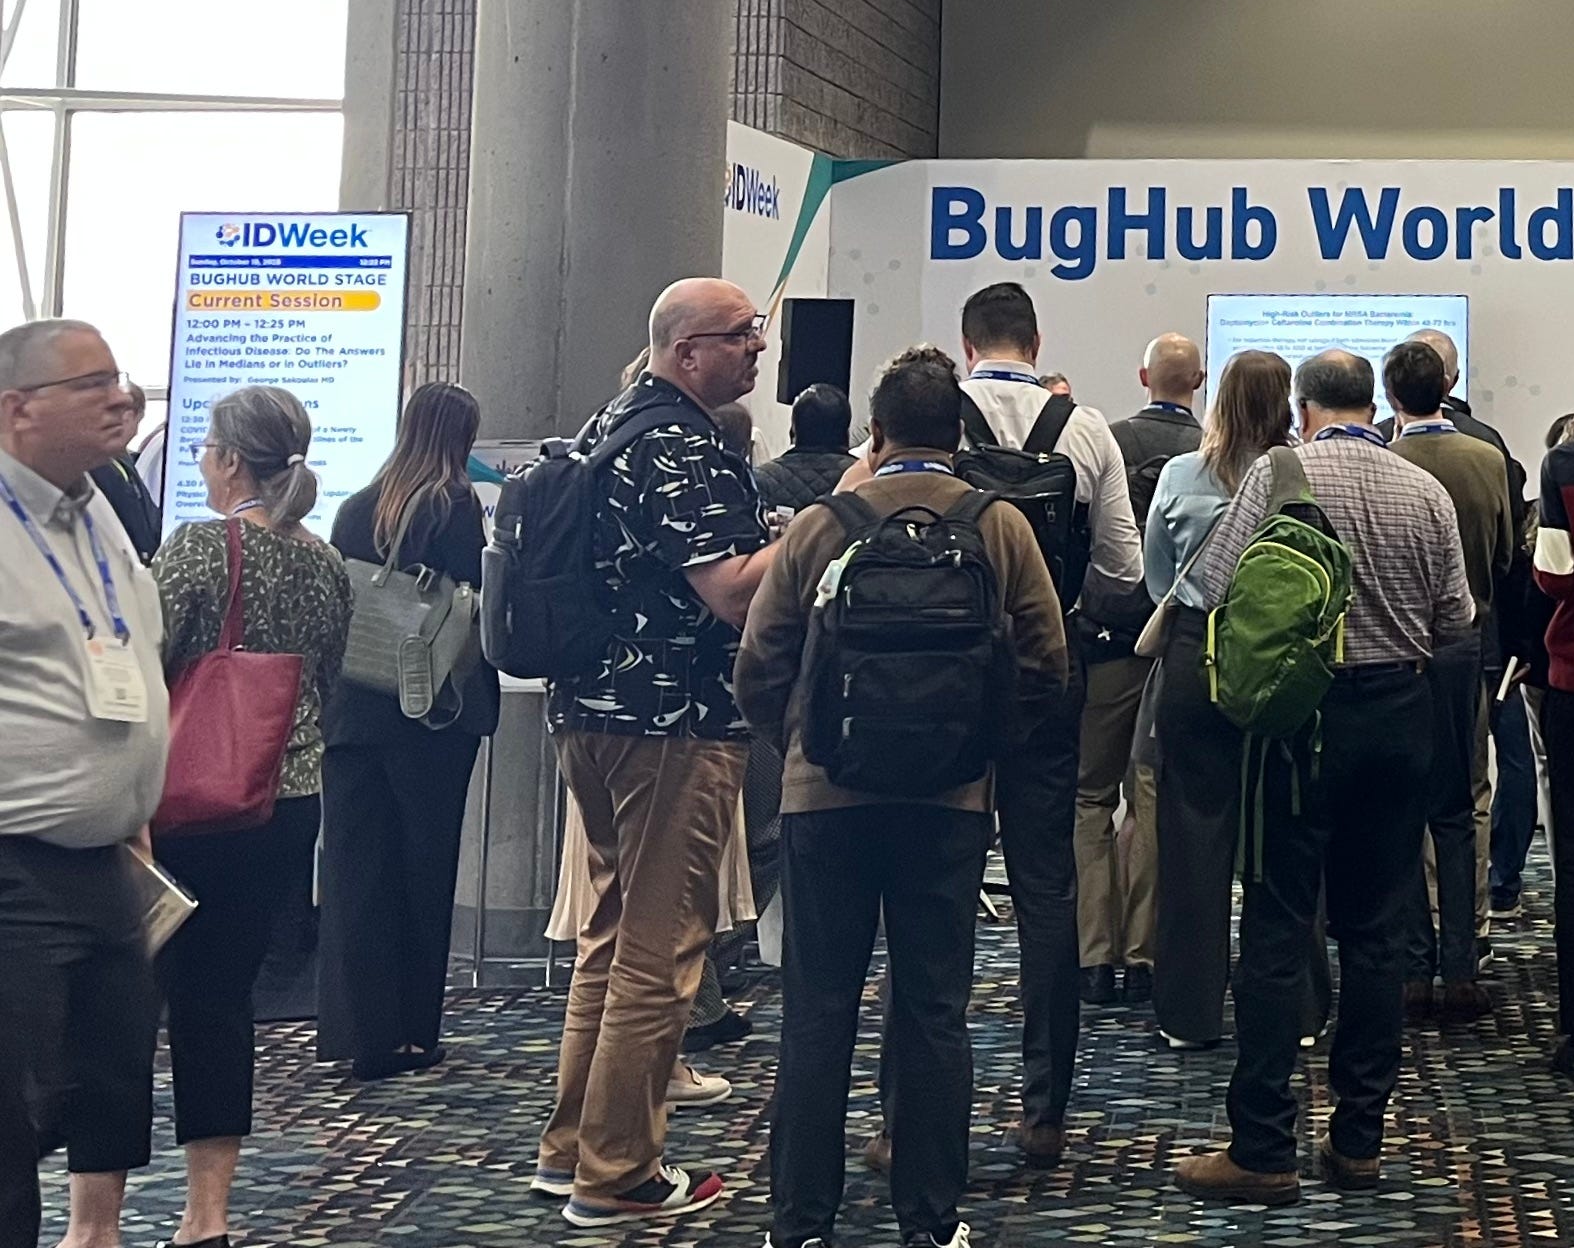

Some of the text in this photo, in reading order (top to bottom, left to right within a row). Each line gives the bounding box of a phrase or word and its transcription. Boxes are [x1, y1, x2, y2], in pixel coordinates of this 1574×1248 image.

[732, 162, 780, 220] IDWeek
[243, 223, 368, 248] IDWeek
[929, 186, 1278, 280] BugHub
[1309, 186, 1574, 261] World
[190, 273, 387, 286] BUGHUB WORLD STAGE
[189, 293, 342, 309] Current Session
[187, 319, 219, 329] 12:00
[224, 319, 241, 329] PM
[255, 319, 284, 329] 12:25
[288, 319, 306, 329] PM
[186, 334, 333, 344] Advancing the Practice of
[186, 347, 242, 356] Infectious
[295, 347, 310, 355] Do
[315, 347, 334, 356] The
[339, 347, 386, 356] Answers
[185, 360, 202, 369] Lie
[219, 360, 265, 369] Medians
[298, 360, 348, 369] Outliers?
